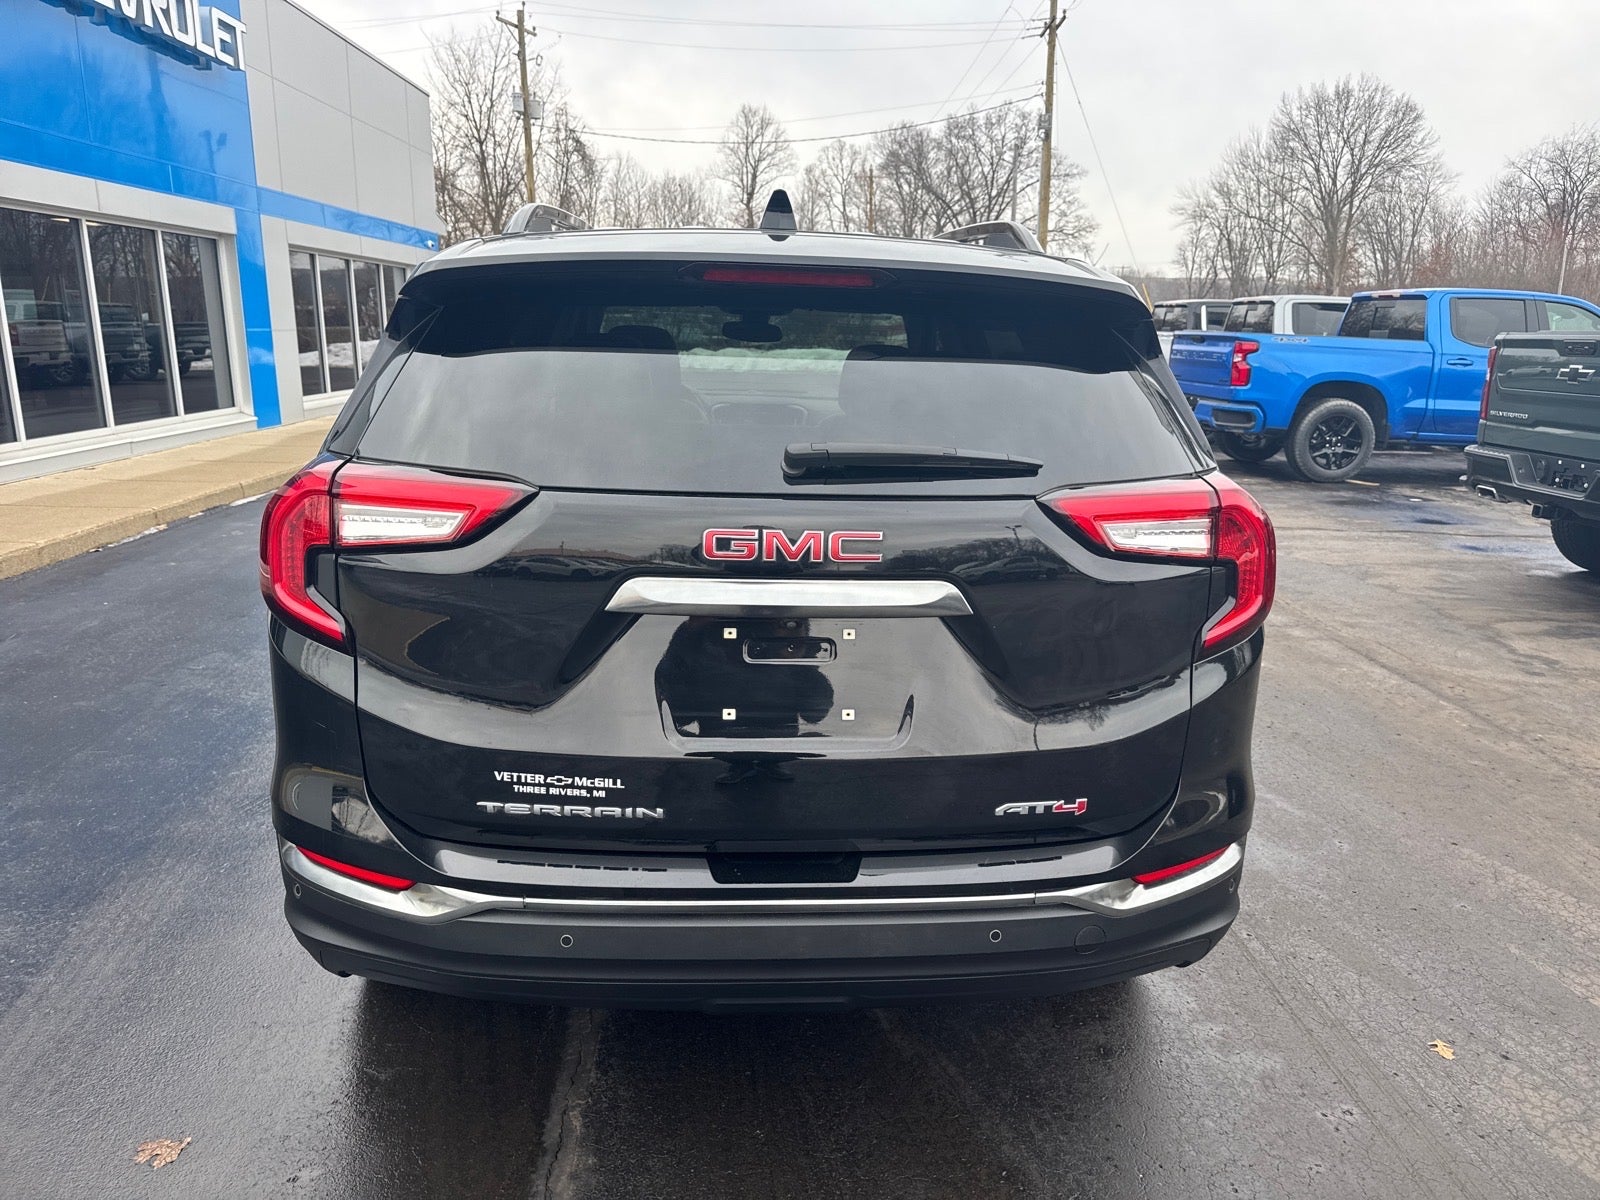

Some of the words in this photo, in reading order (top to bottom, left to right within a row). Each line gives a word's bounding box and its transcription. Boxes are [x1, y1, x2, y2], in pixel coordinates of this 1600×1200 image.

[94, 0, 247, 71] ROLET
[703, 528, 884, 563] GMC
[494, 771, 545, 785] VETTER
[574, 776, 625, 789] McGILL
[513, 785, 547, 795] THREE
[593, 789, 606, 798] MI
[476, 801, 665, 819] TERRAIN
[995, 798, 1088, 816] AT4
